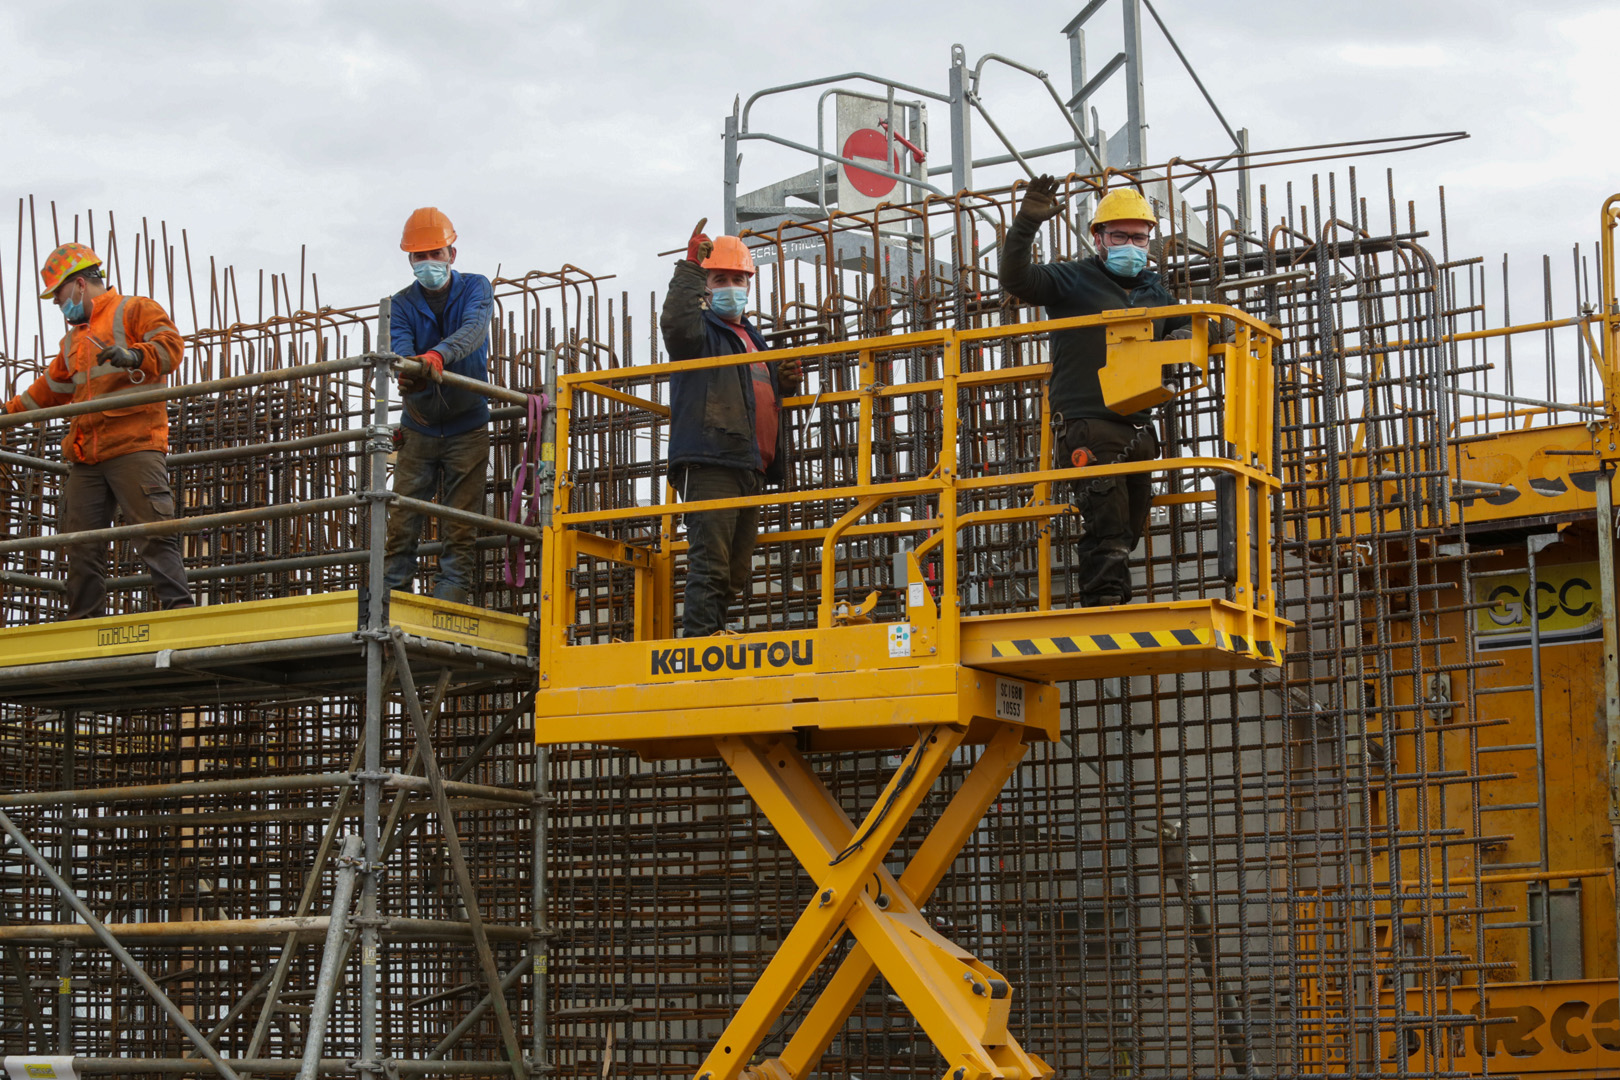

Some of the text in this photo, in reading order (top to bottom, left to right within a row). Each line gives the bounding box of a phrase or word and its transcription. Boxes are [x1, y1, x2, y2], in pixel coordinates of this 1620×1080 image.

[1488, 578, 1593, 625] GCC
[651, 639, 813, 675] KILOUTOU
[1003, 700, 1020, 717] 10553
